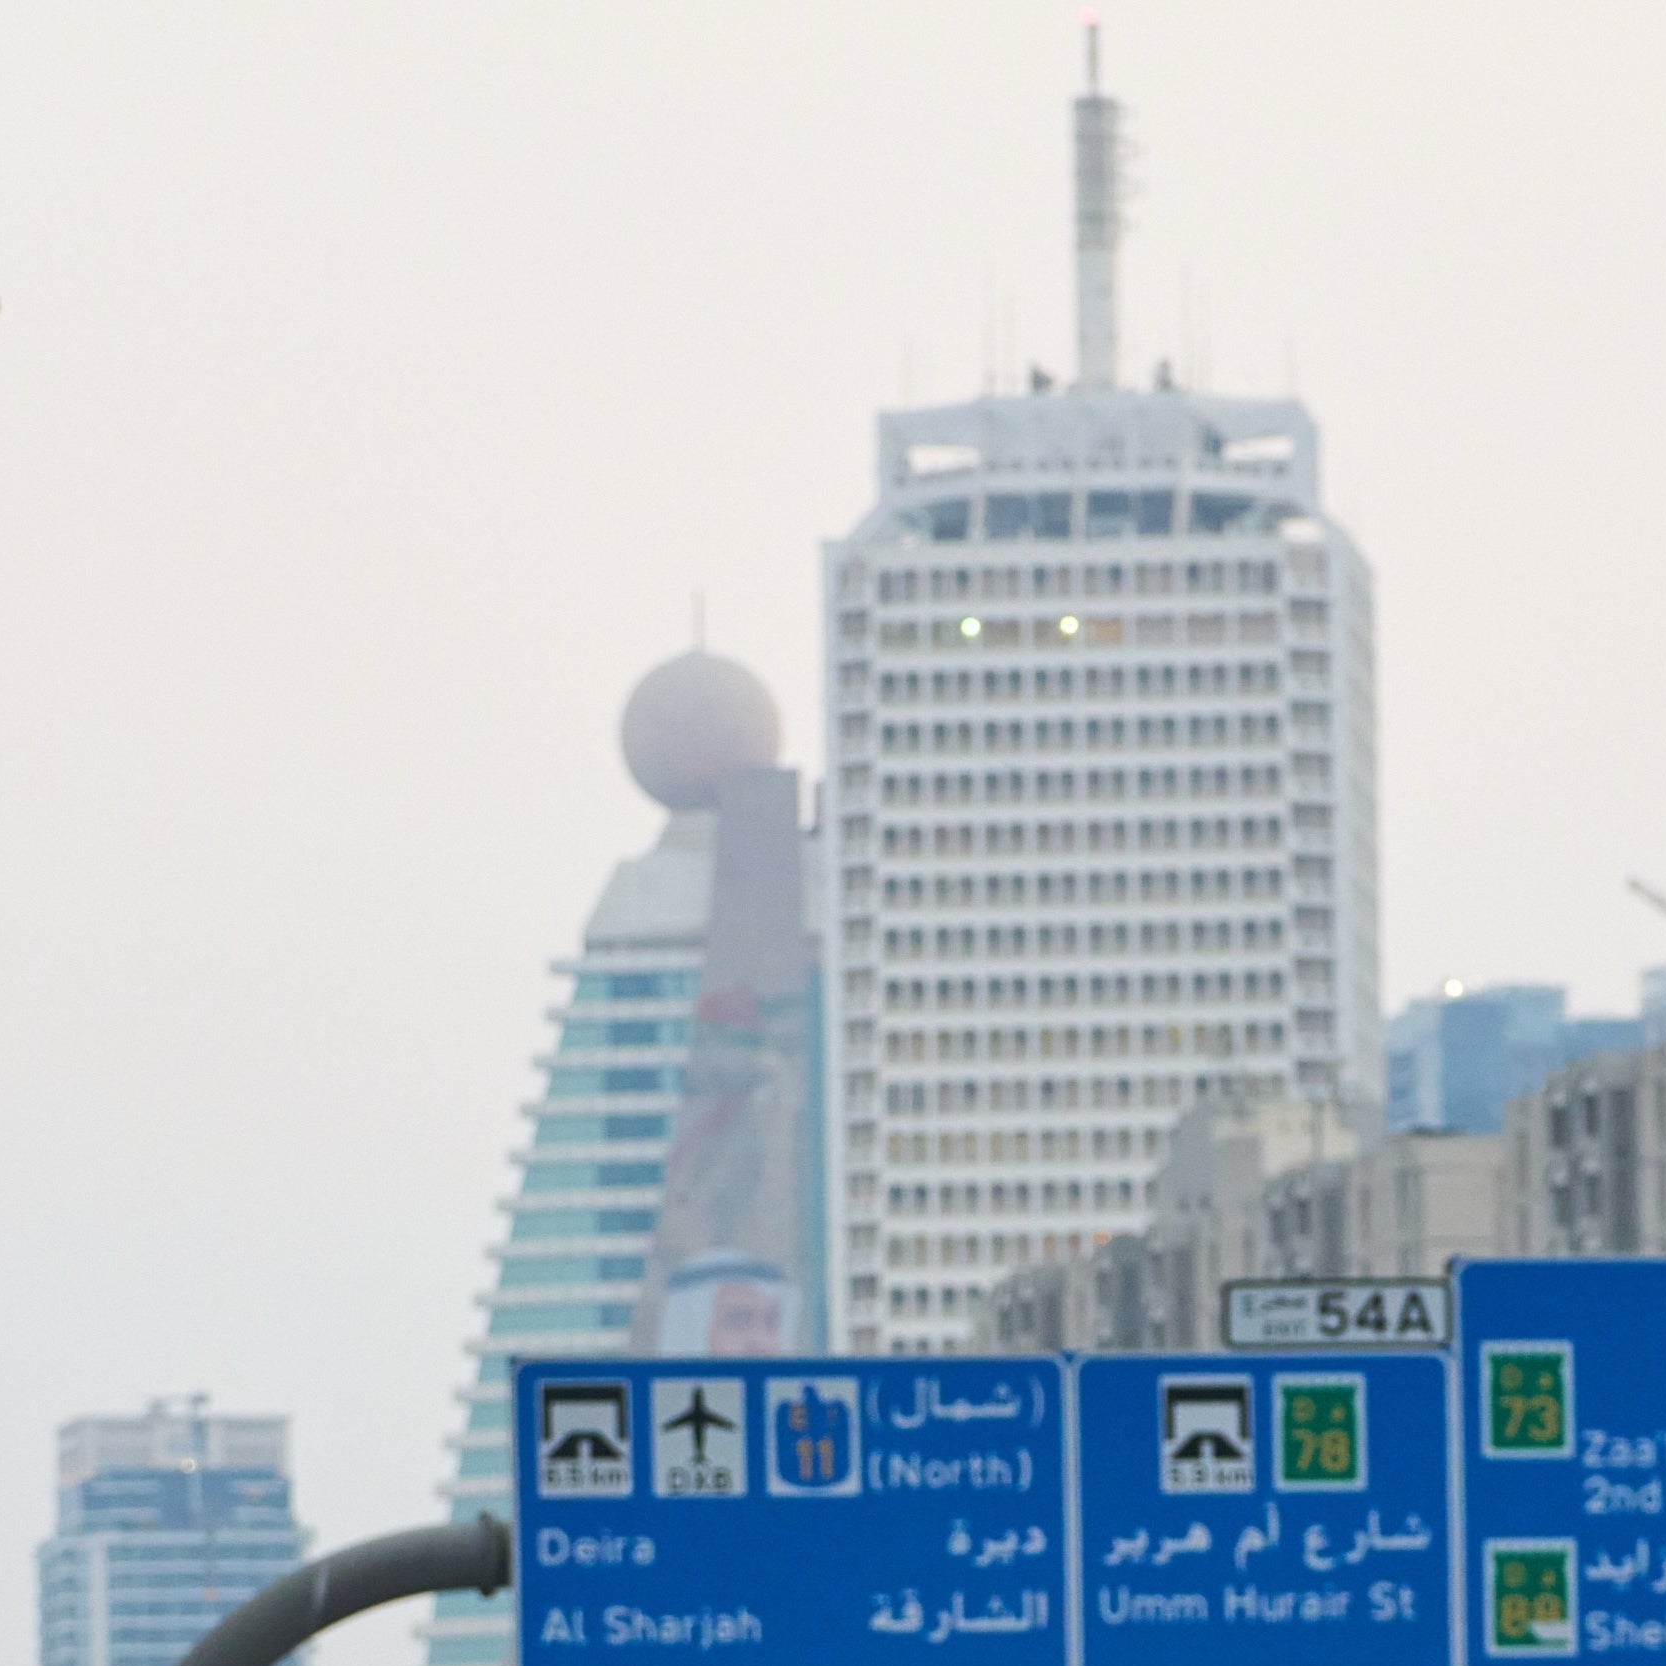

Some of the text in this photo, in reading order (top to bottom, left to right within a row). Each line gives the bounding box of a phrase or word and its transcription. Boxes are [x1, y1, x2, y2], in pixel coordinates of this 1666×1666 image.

[1317, 1290, 1432, 1337] 54A
[1499, 1394, 1561, 1441] 73
[796, 1437, 835, 1480] 11
[868, 1450, 1033, 1492] (North)
[1292, 1428, 1350, 1473] 78
[1584, 1475, 1662, 1514] 2nd
[538, 1526, 656, 1567] Deira
[947, 1517, 1047, 1567] ديرة
[1304, 1509, 1431, 1571] شارع
[869, 1587, 1050, 1642] الشارقة
[1099, 1580, 1414, 1625] Umm Hurair St
[541, 1605, 763, 1651] Al Sharjah
